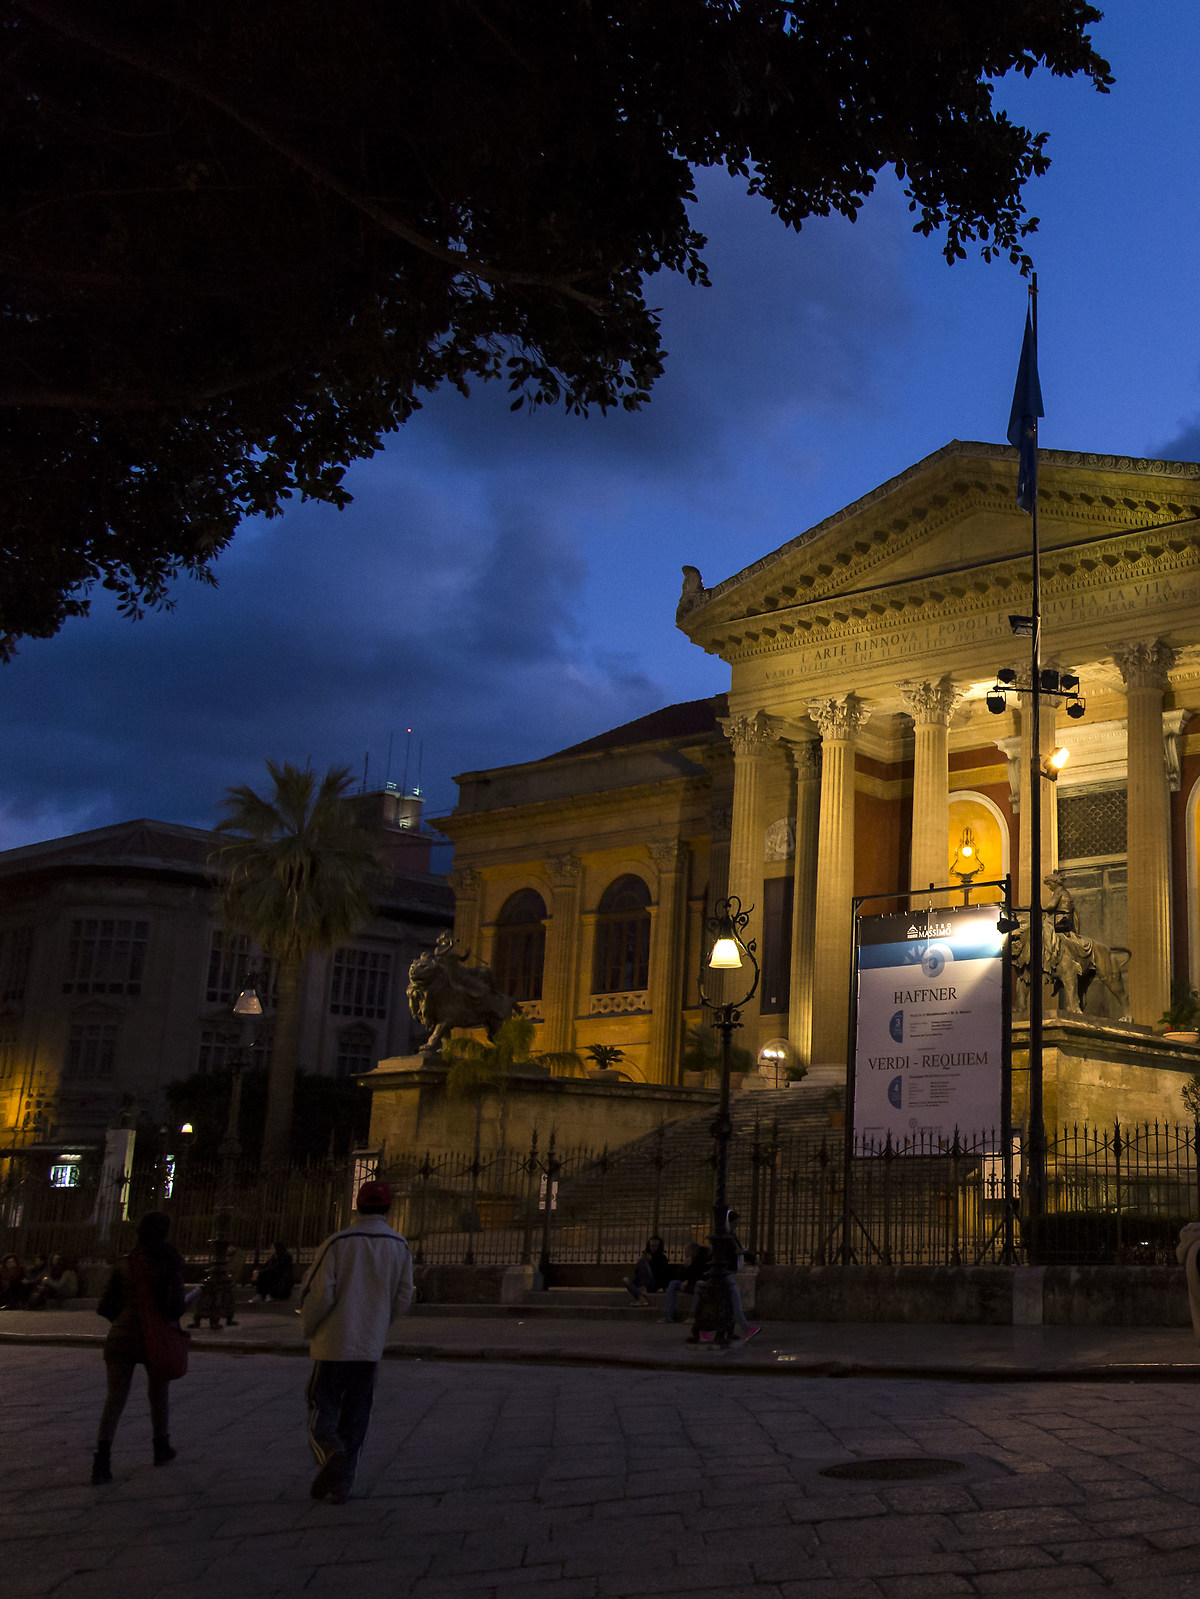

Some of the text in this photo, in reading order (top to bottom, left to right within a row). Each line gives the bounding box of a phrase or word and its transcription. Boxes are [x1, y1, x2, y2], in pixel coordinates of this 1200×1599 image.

[855, 631, 918, 653] RINNOVA
[939, 616, 989, 636] POPOLI
[1108, 589, 1125, 603] LA
[1134, 579, 1172, 597] VITA
[1072, 600, 1137, 619] PREPARAR
[918, 922, 952, 931] TEATRO
[918, 927, 952, 939] MASSIMO
[894, 987, 958, 1004] HAFFNER
[895, 1018, 901, 1027] 3
[868, 1055, 910, 1071] VERDI
[922, 1051, 989, 1070] REQUIEM
